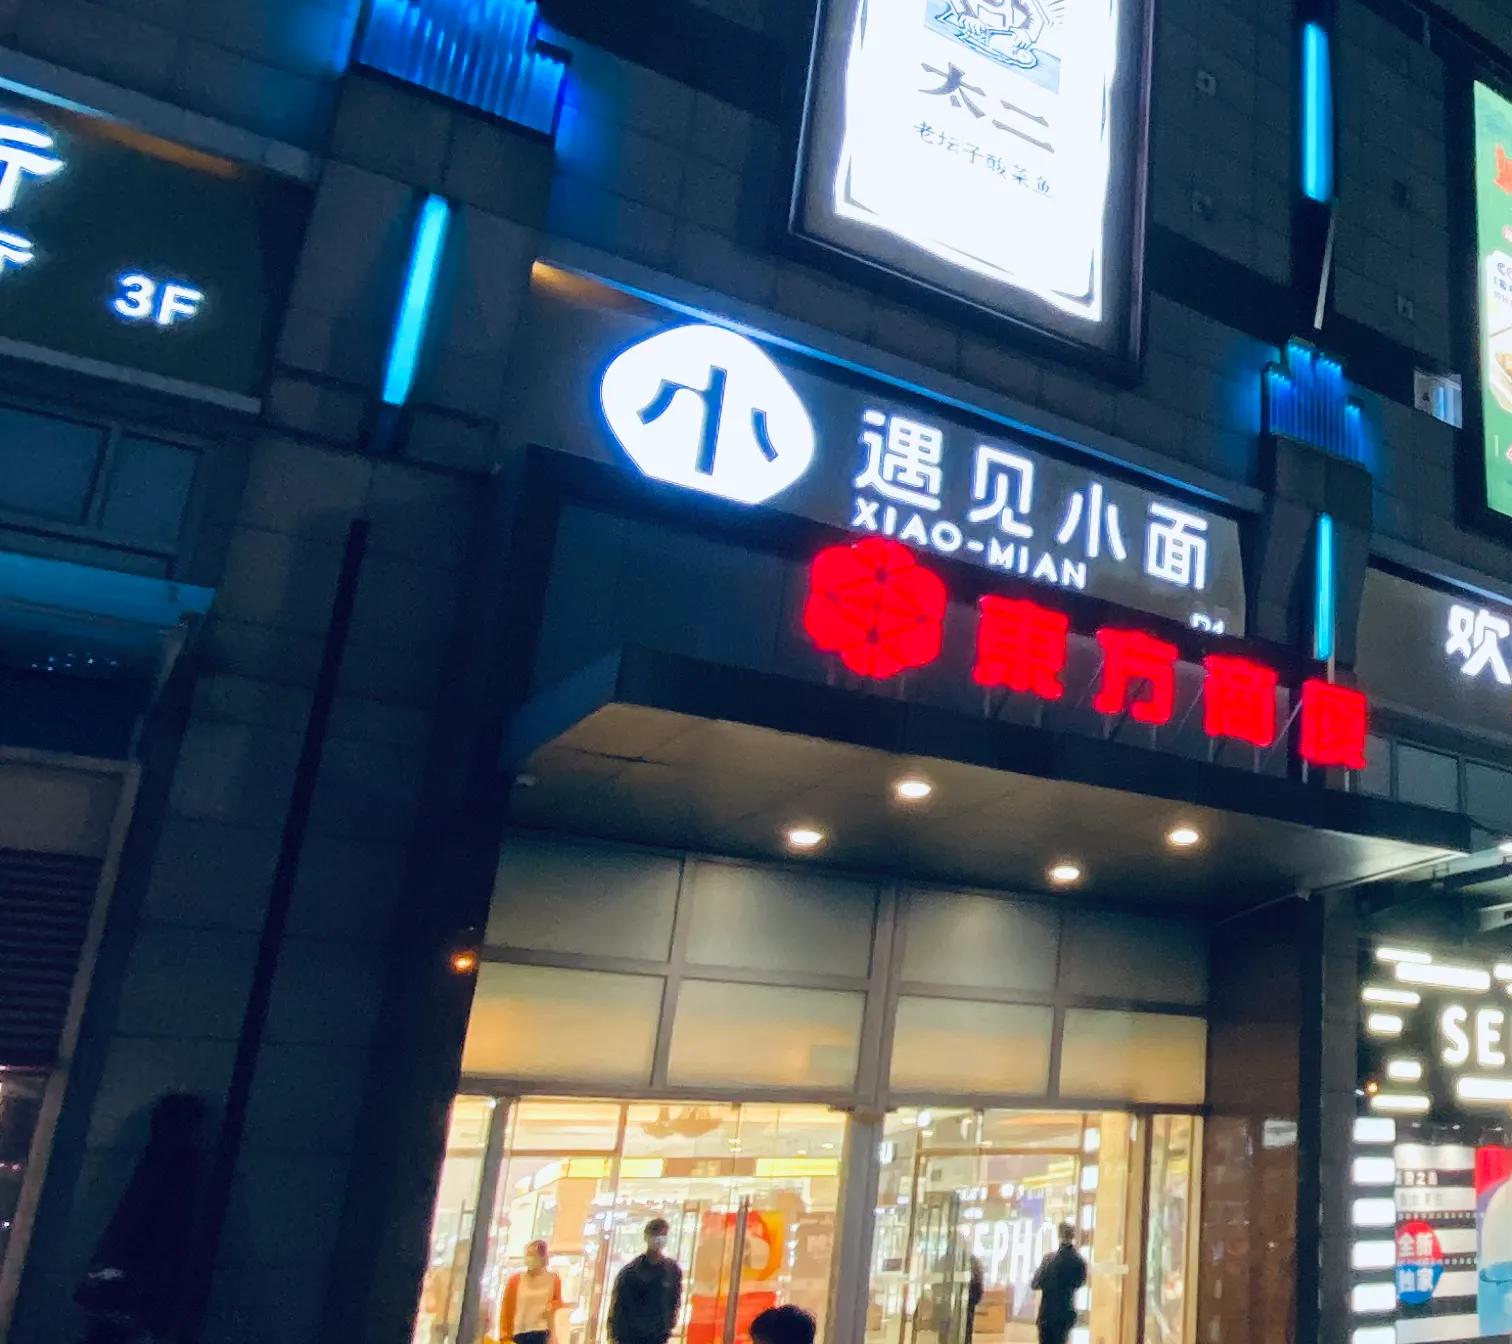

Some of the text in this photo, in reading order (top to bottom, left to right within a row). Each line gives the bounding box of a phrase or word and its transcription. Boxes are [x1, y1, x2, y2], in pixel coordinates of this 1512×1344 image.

[917, 61, 1056, 155] 太二
[912, 119, 1055, 199] 老坛子酸菜鱼
[111, 272, 206, 327] 3F
[852, 408, 1209, 591] 遇见小面
[852, 497, 1088, 589] XIAO-MIAN
